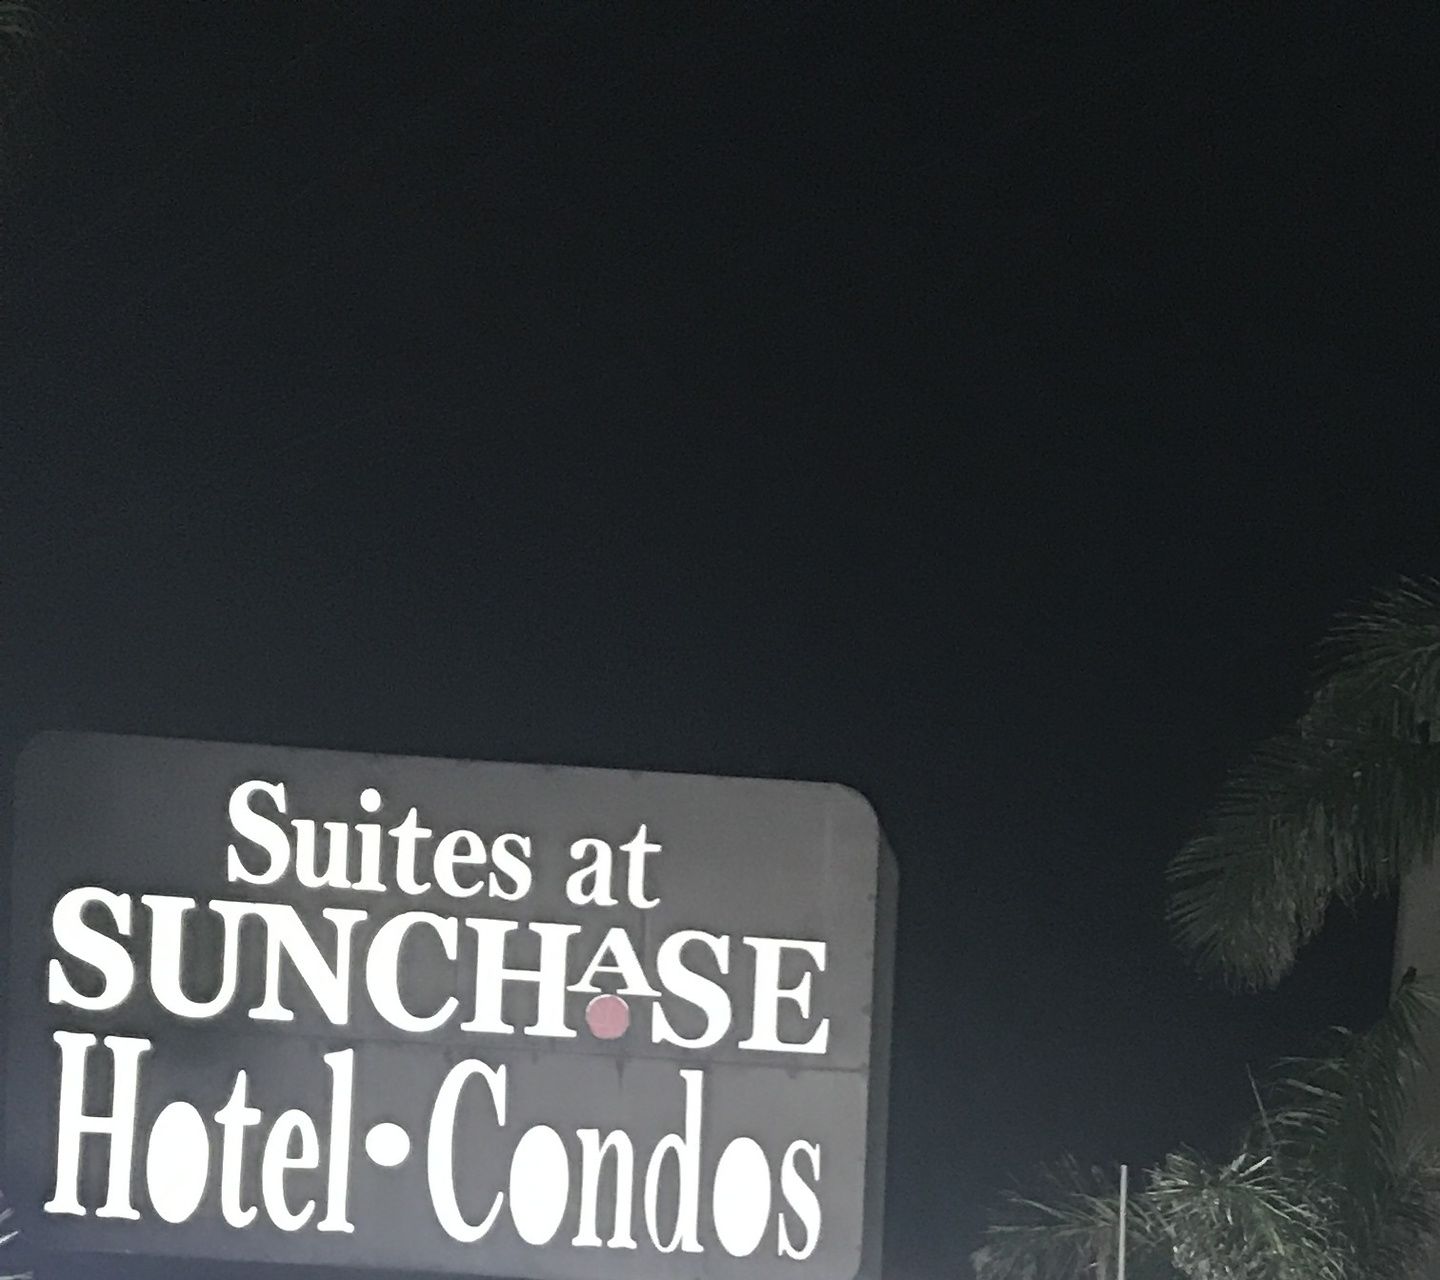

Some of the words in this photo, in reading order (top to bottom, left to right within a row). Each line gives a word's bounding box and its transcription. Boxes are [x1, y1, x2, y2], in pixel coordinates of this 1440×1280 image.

[226, 779, 533, 901] Suites
[565, 823, 662, 909] at
[48, 886, 830, 1054] SUNCHASE
[44, 1031, 355, 1234] Hotel
[427, 1058, 822, 1261] Condos
